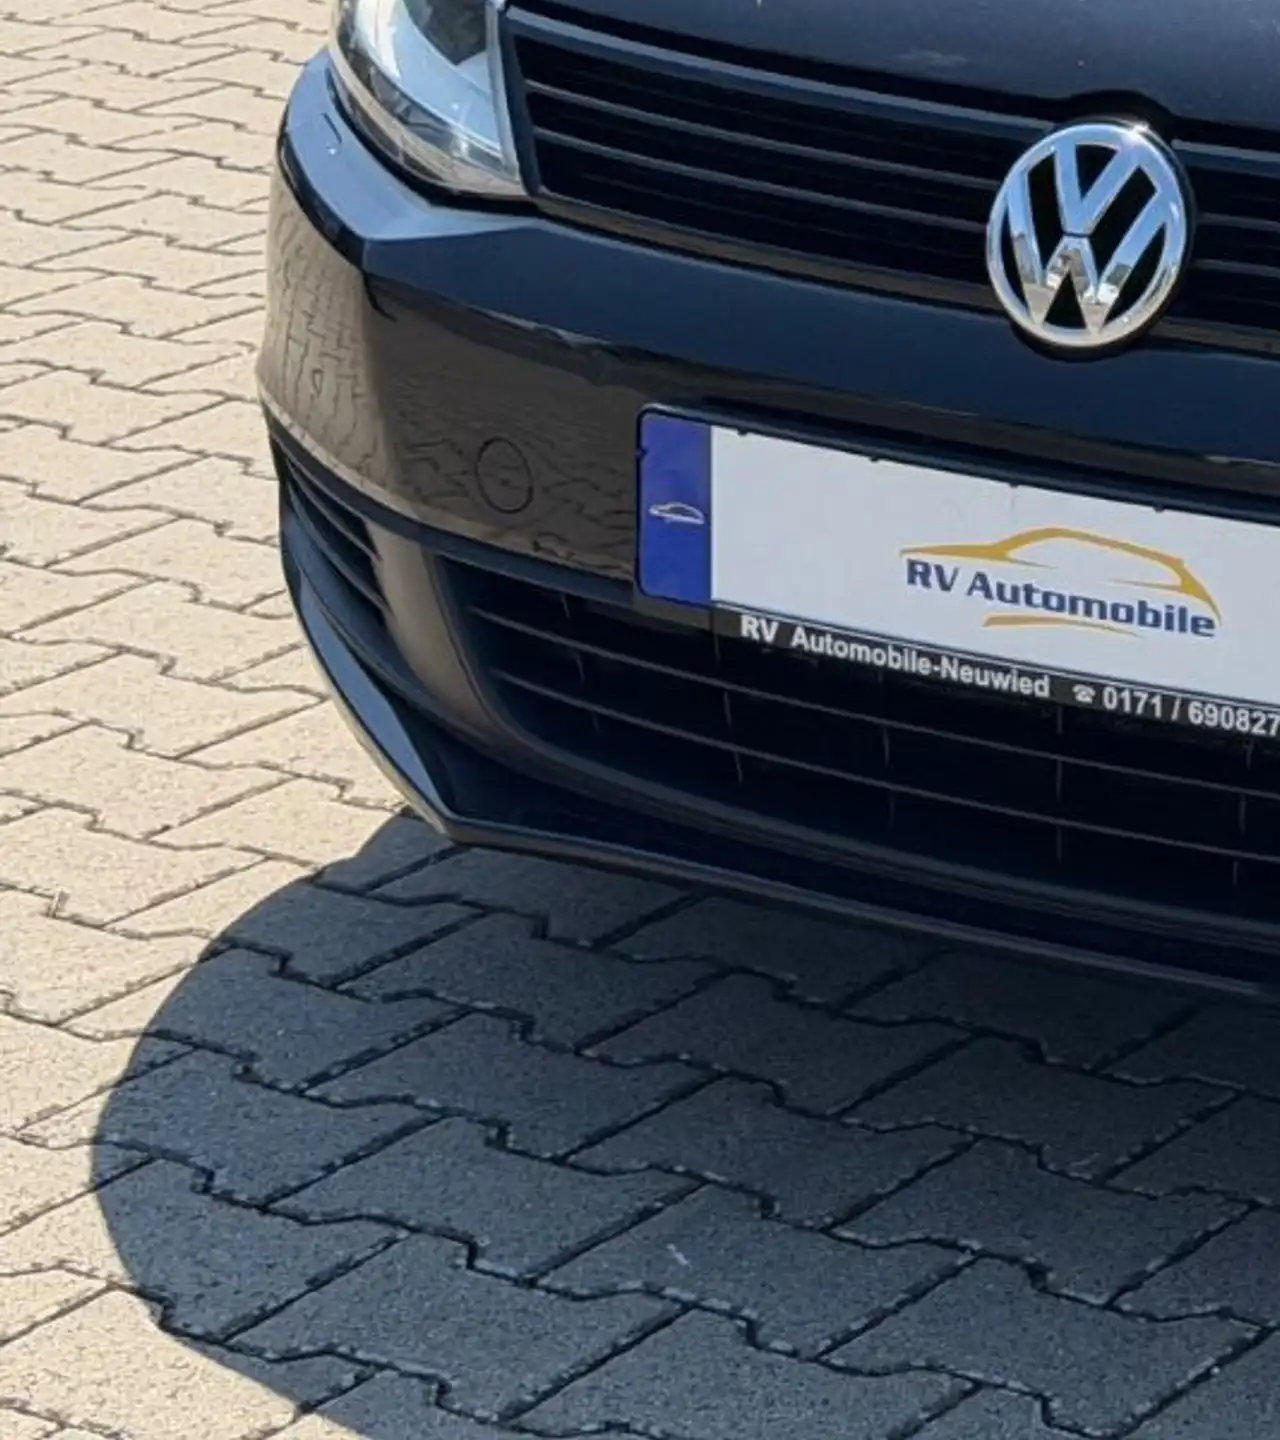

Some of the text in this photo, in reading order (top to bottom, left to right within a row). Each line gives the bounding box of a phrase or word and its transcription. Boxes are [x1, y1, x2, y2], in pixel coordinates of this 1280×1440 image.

[986, 122, 1187, 348] VW
[906, 558, 1217, 638] RV Automobile
[740, 614, 779, 643] RV
[791, 625, 1051, 698] Automobile-Neuwied
[1102, 686, 1162, 718] 0171
